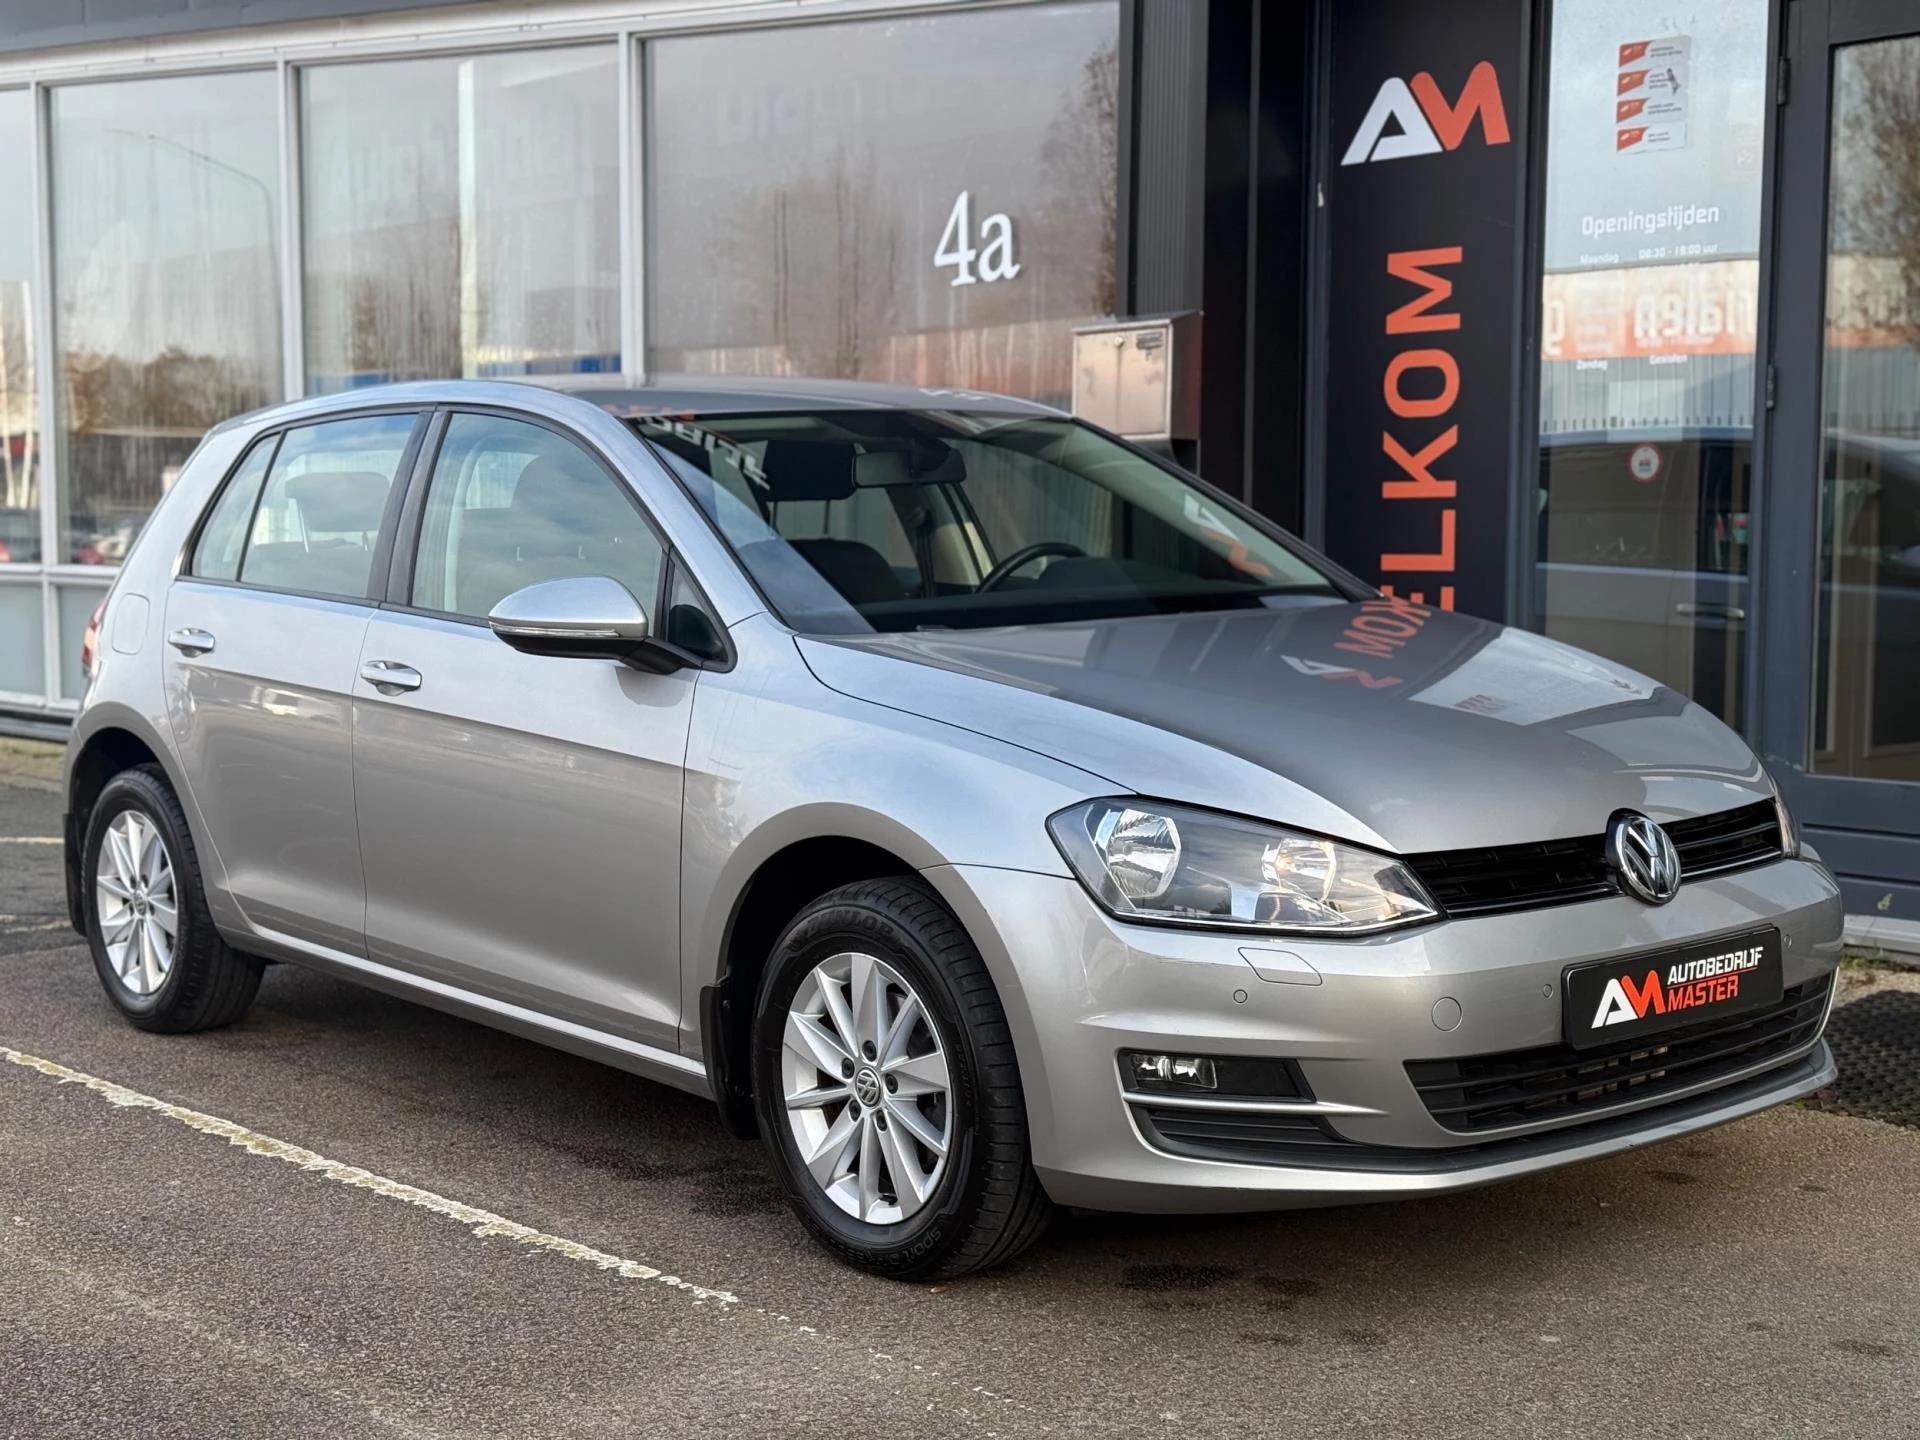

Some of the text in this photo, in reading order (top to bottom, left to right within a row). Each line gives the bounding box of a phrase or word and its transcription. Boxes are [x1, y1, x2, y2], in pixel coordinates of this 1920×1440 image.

[1340, 60, 1511, 167] AM
[933, 190, 1020, 287] 4a
[1582, 204, 1719, 238] Openingstijden
[1667, 946, 1764, 986] AUTOBEDRIJF
[1590, 970, 1667, 1030] AM
[1667, 974, 1740, 1013] MASTER
